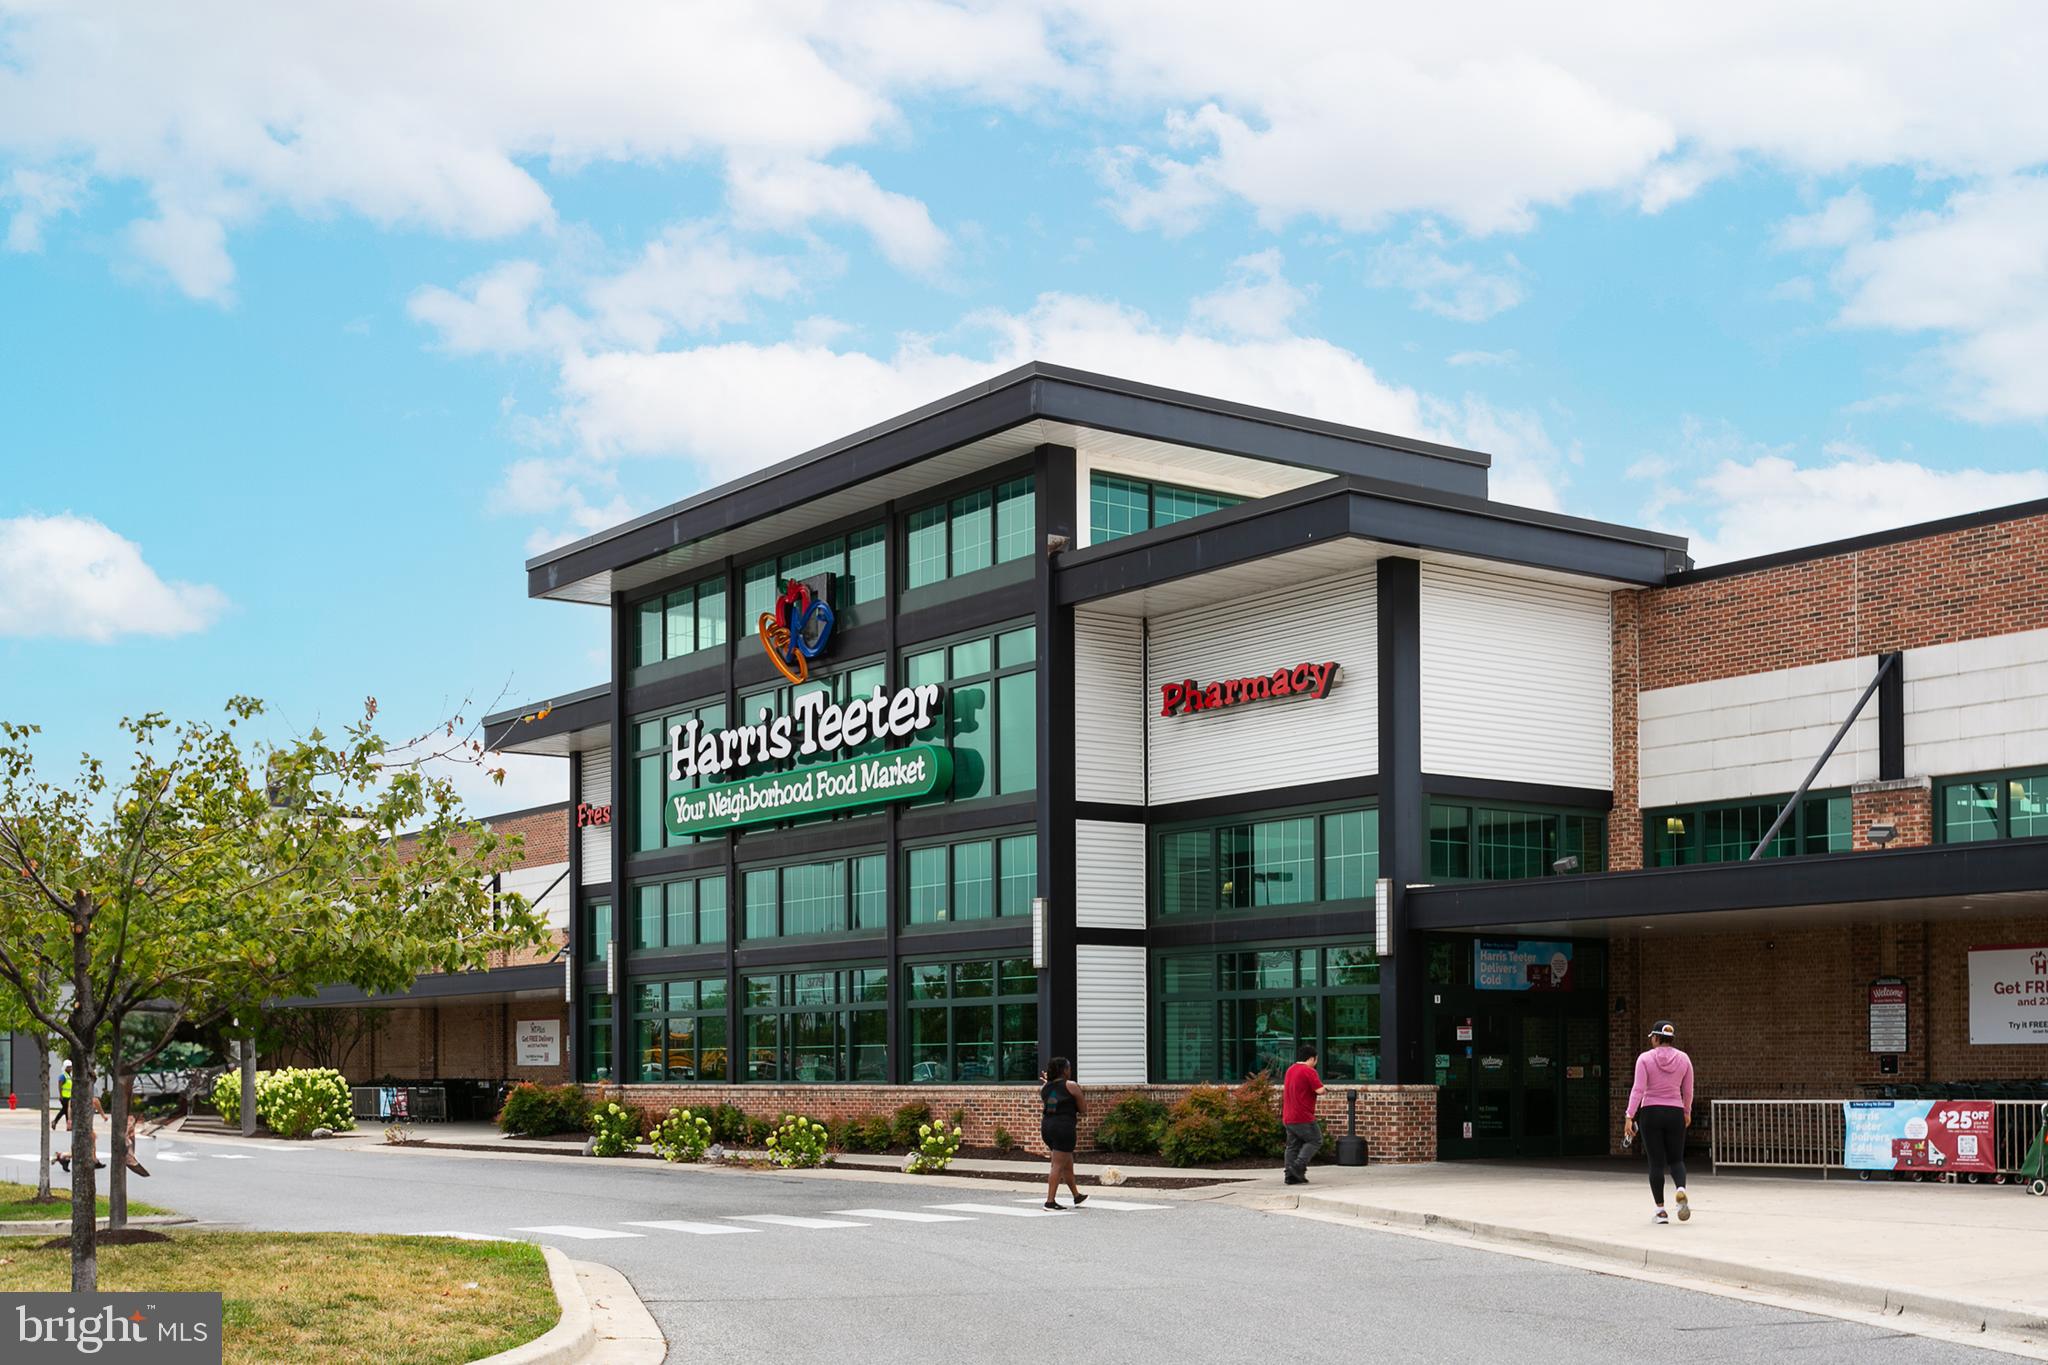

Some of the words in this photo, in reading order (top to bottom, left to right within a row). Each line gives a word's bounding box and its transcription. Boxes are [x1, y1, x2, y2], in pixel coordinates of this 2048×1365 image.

[1160, 661, 1338, 717] Pharmacy
[669, 706, 793, 781] Harris
[794, 683, 941, 755] Teeter
[673, 796, 706, 823] Your
[708, 771, 813, 822] Neighborhood
[816, 764, 857, 798] Food
[860, 755, 926, 791] Market
[577, 801, 611, 828] Fres
[1481, 950, 1507, 961] Harris
[1508, 951, 1536, 963] Teeter
[1481, 962, 1517, 974] Delivers
[2034, 960, 2048, 975] H
[1481, 974, 1501, 985] Cold
[1873, 986, 1904, 998] Welcome
[1994, 981, 2021, 995] Get
[2025, 980, 2048, 994] FR
[2017, 997, 2036, 1006] and
[2008, 1021, 2021, 1030] Try
[2028, 1020, 2048, 1029] FREE
[1481, 1056, 1503, 1066] Welcome
[1851, 1110, 1879, 1121] Harris
[1939, 1110, 1972, 1129] $25
[1972, 1110, 1989, 1120] OFF
[1851, 1122, 1882, 1132] Teeter
[1851, 1133, 1891, 1142] Delivers
